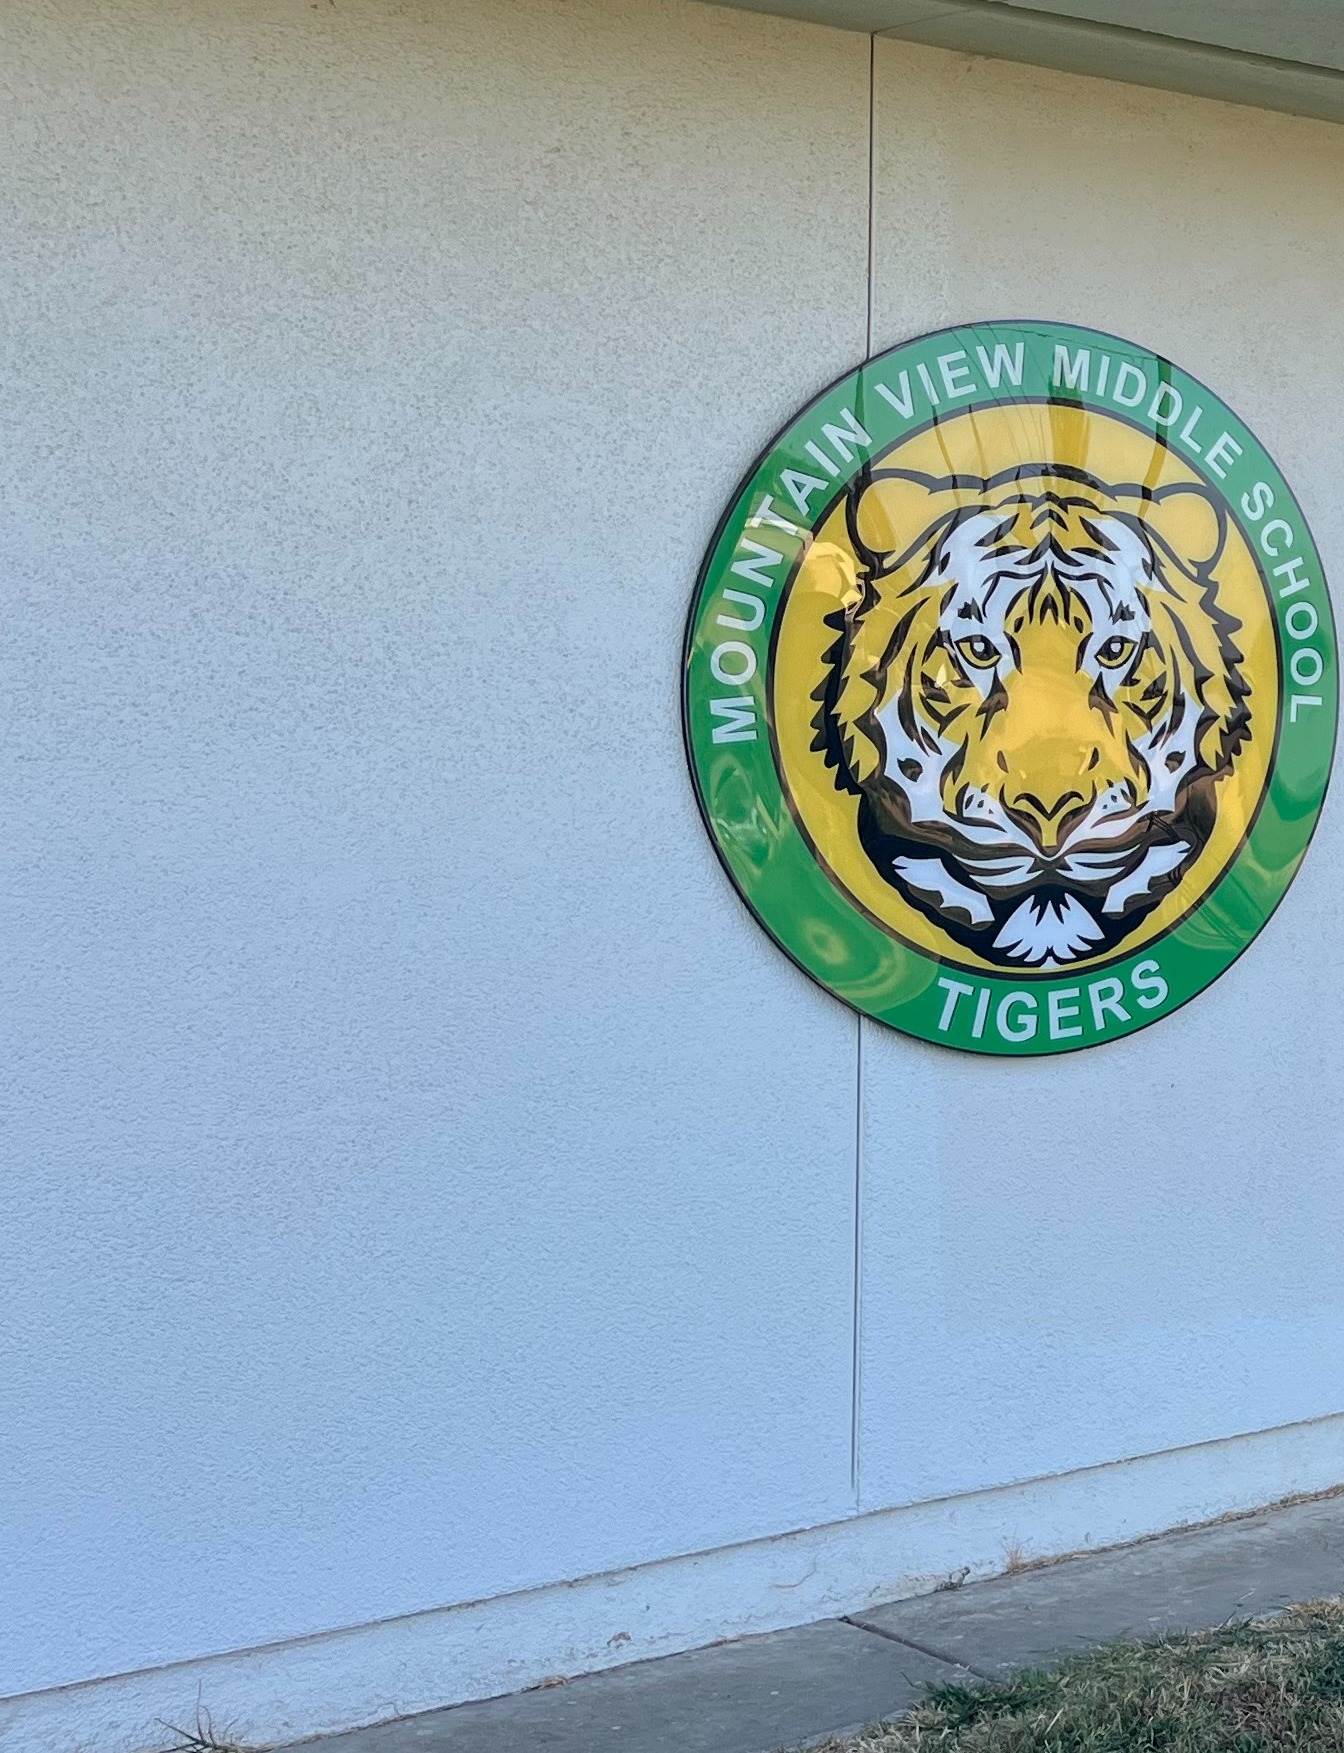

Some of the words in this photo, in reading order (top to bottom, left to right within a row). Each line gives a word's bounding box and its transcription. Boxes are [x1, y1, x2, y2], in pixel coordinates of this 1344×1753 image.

[710, 408, 872, 746] MOUNTAIN
[874, 342, 1026, 422] VIEW
[1052, 344, 1243, 478] MIDDLE
[1240, 480, 1323, 723] SCHOOL
[936, 958, 1170, 1042] TIGERS
